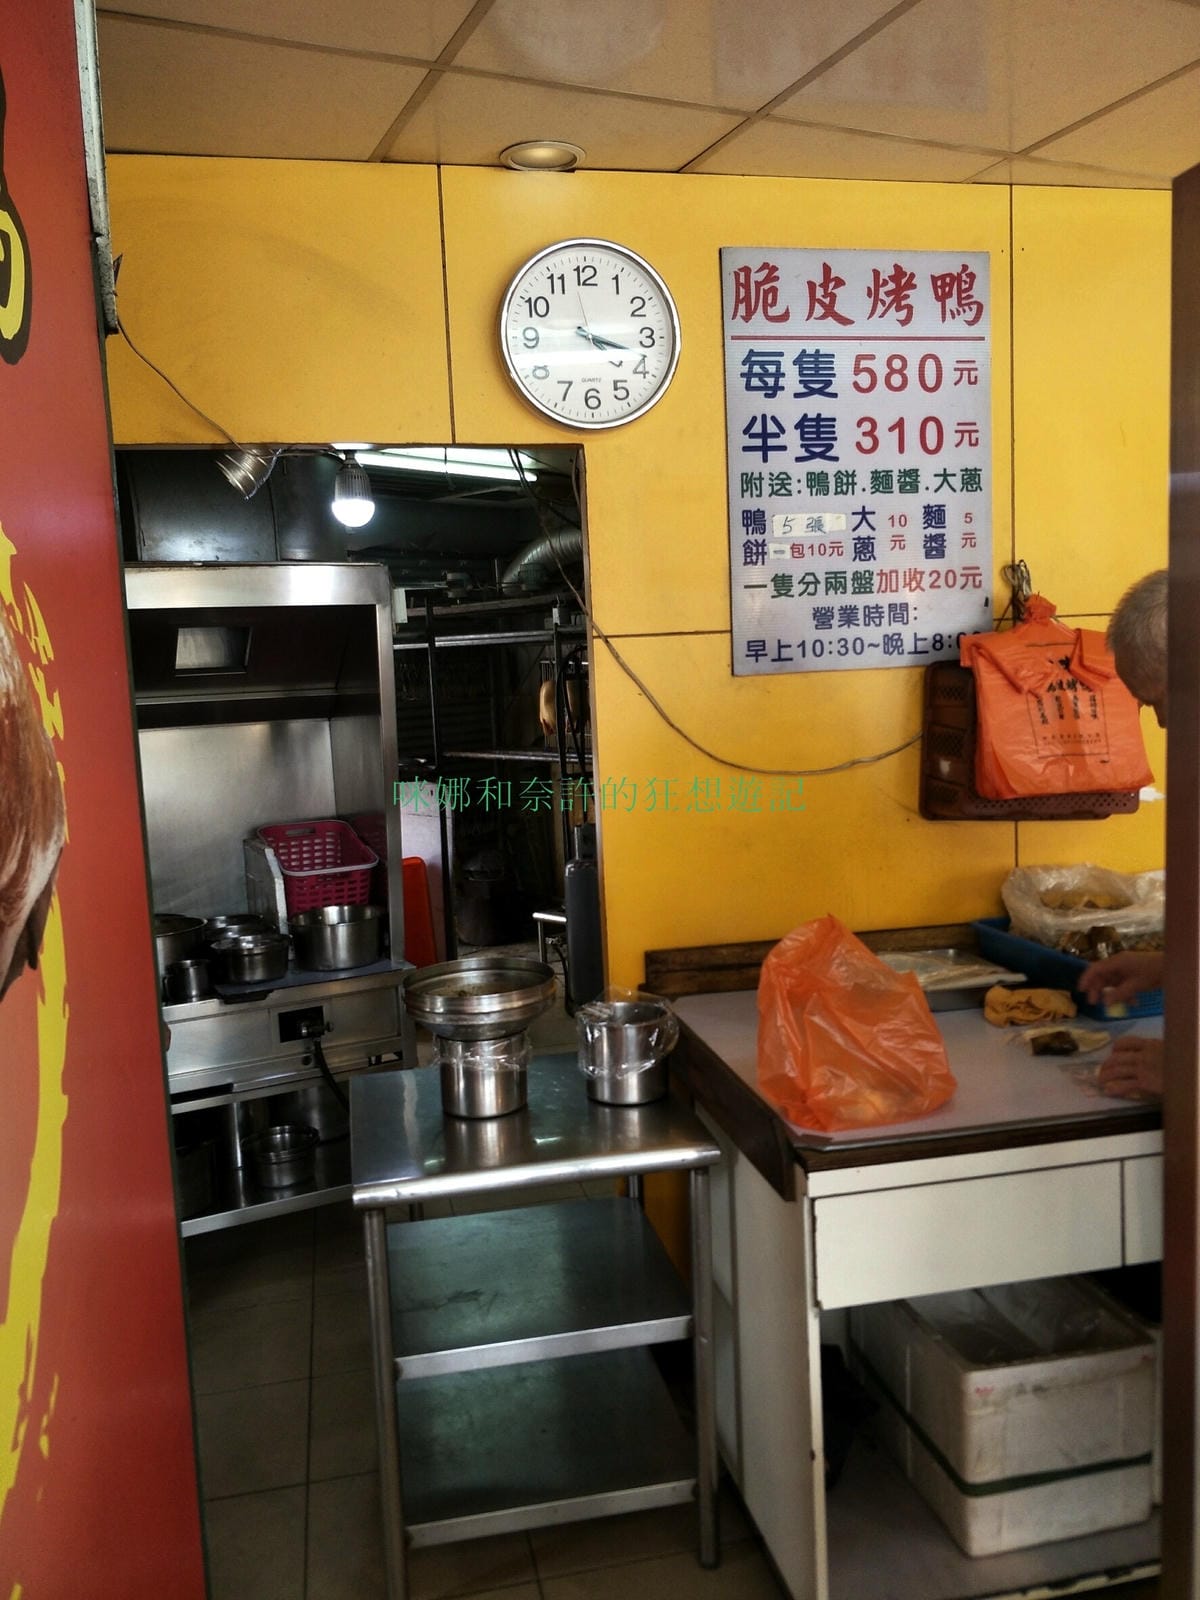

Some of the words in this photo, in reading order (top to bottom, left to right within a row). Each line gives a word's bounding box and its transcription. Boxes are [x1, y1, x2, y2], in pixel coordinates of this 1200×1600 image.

[547, 273, 566, 294] 11
[573, 265, 598, 287] 12
[611, 274, 620, 295] 1
[731, 262, 984, 327] 脆皮烤鴨
[525, 296, 550, 318] 10
[630, 296, 646, 317] 2
[522, 327, 539, 349] 9
[639, 327, 655, 348] 3
[632, 355, 650, 379] 4
[557, 380, 573, 401] 7
[584, 388, 601, 410] 6
[613, 379, 630, 401] 5
